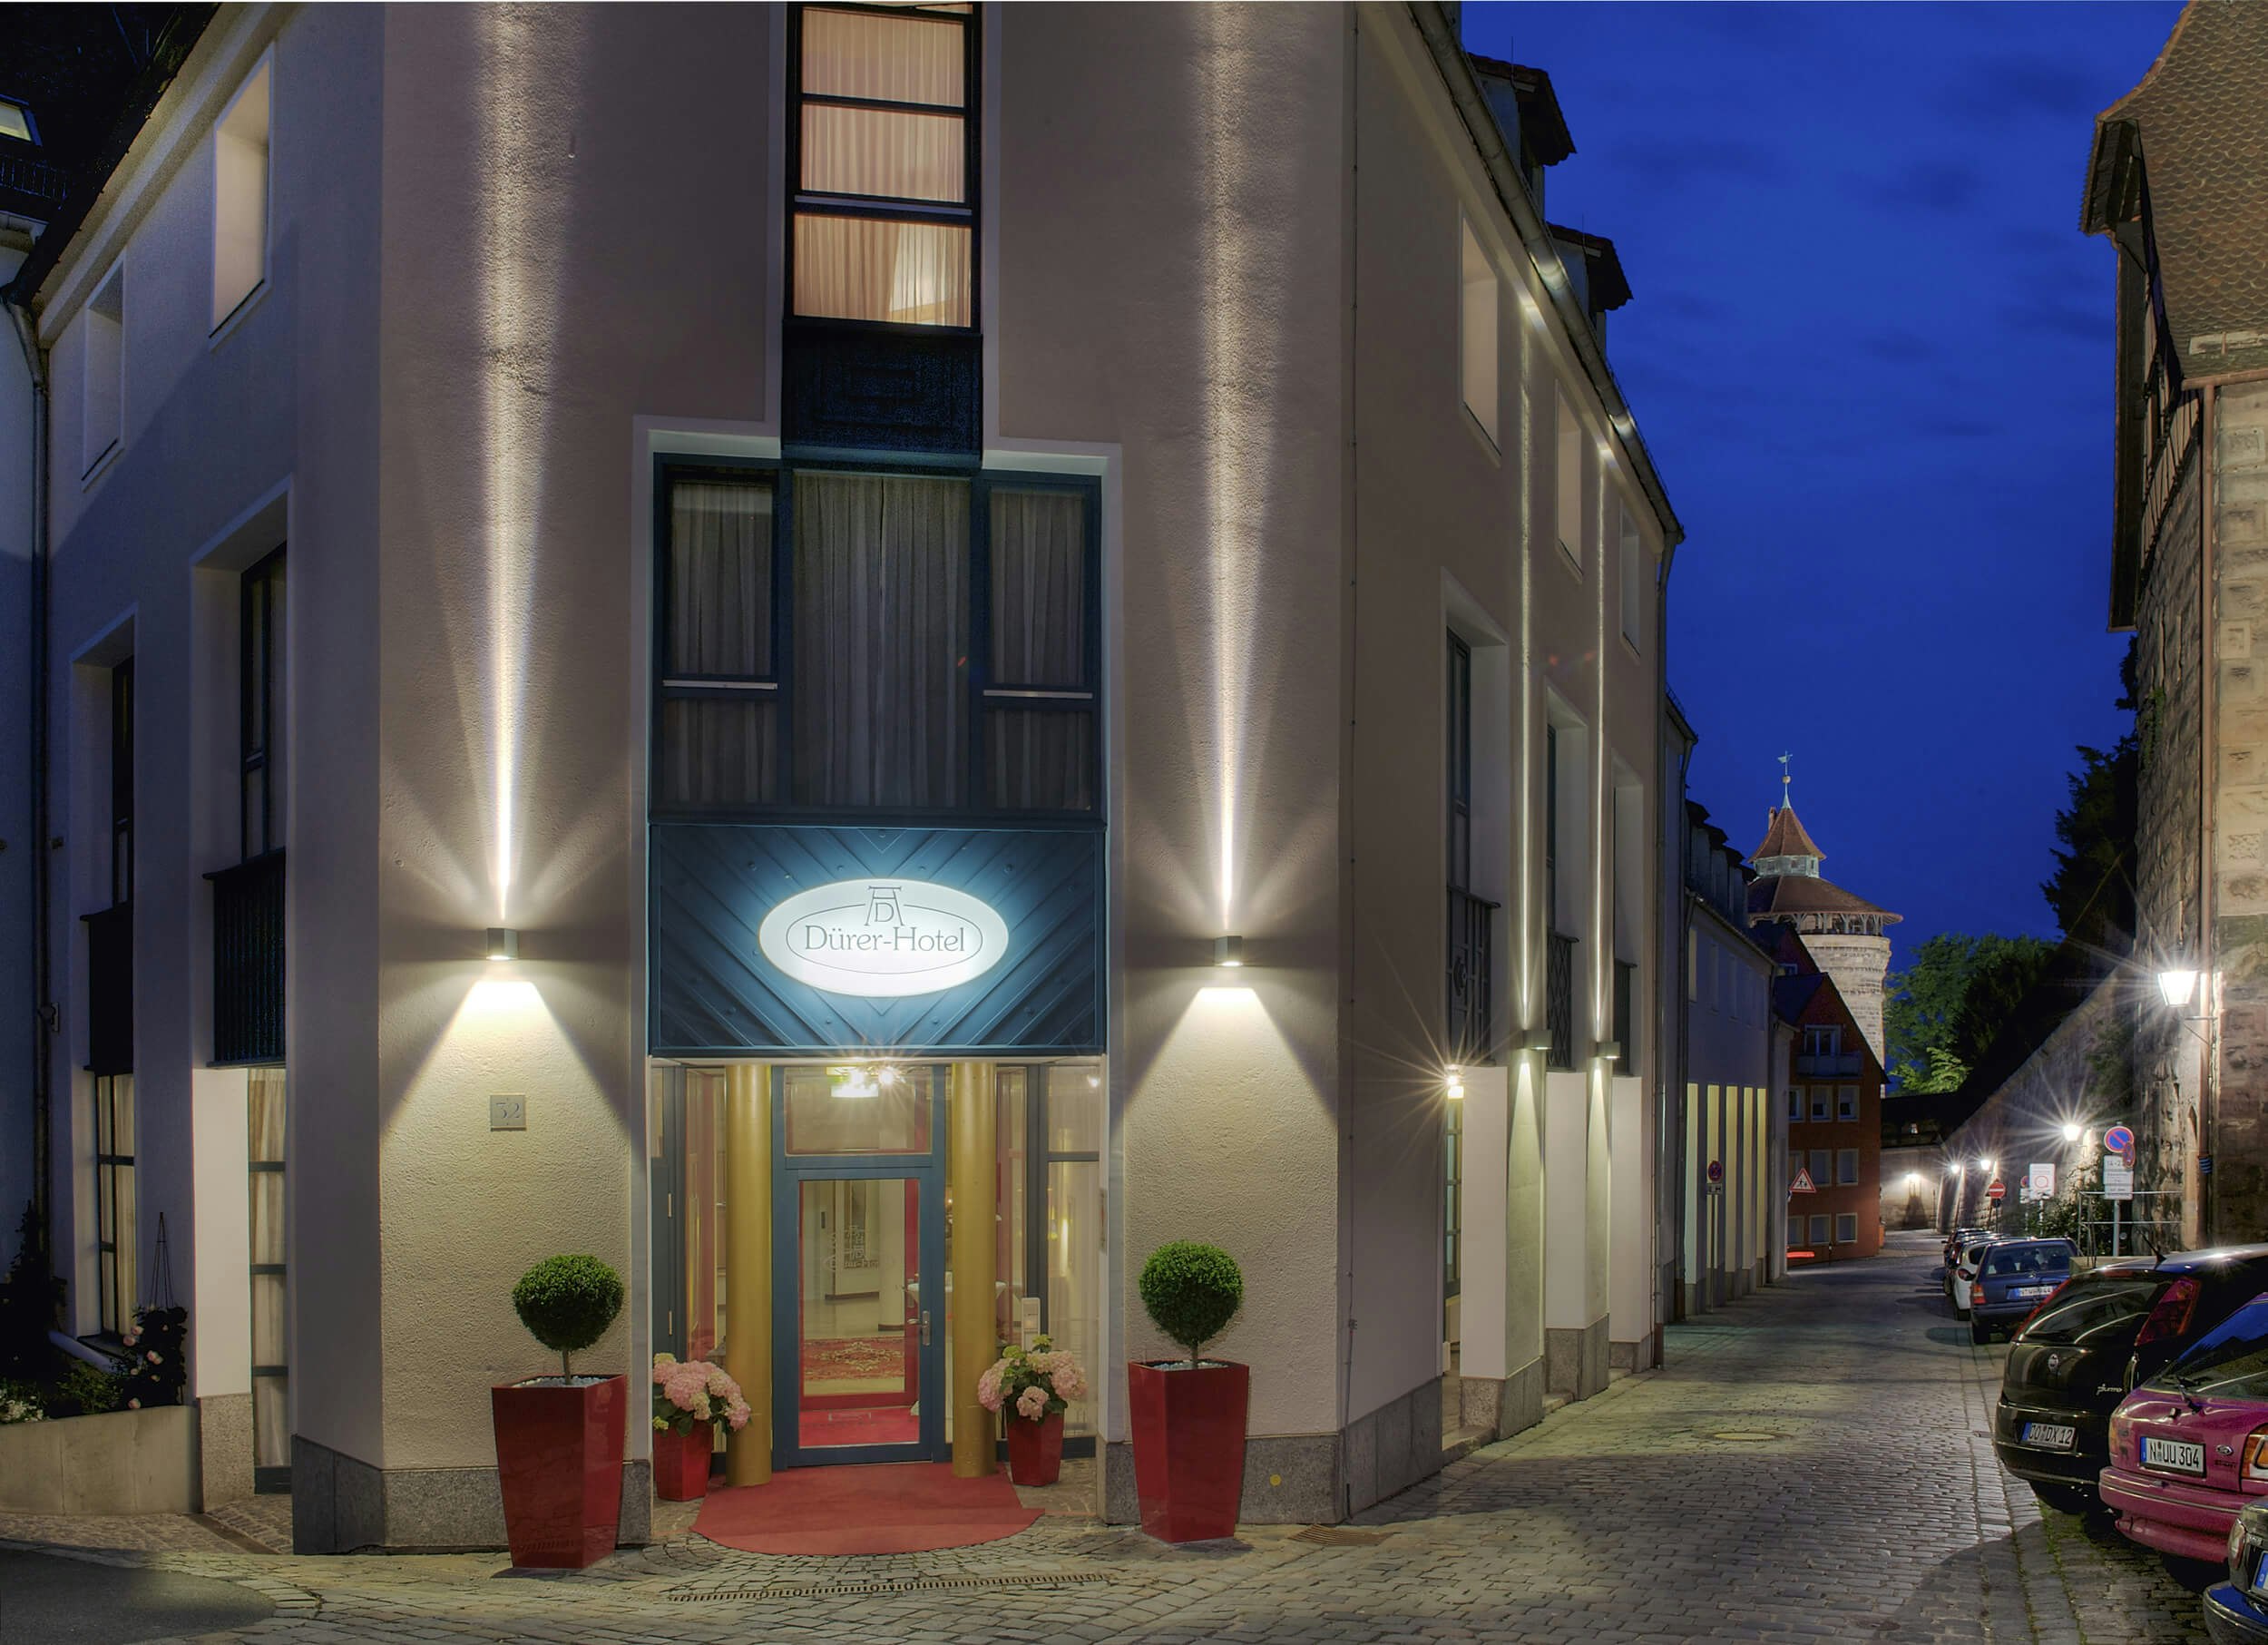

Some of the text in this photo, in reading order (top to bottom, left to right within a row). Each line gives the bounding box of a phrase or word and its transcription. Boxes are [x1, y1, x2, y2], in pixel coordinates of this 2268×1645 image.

[805, 925, 965, 952] Dürer-Hotel
[2045, 1426, 2058, 1443] DX
[2058, 1428, 2073, 1445] 12
[2149, 1441, 2156, 1462] N
[2178, 1445, 2200, 1468] 304
